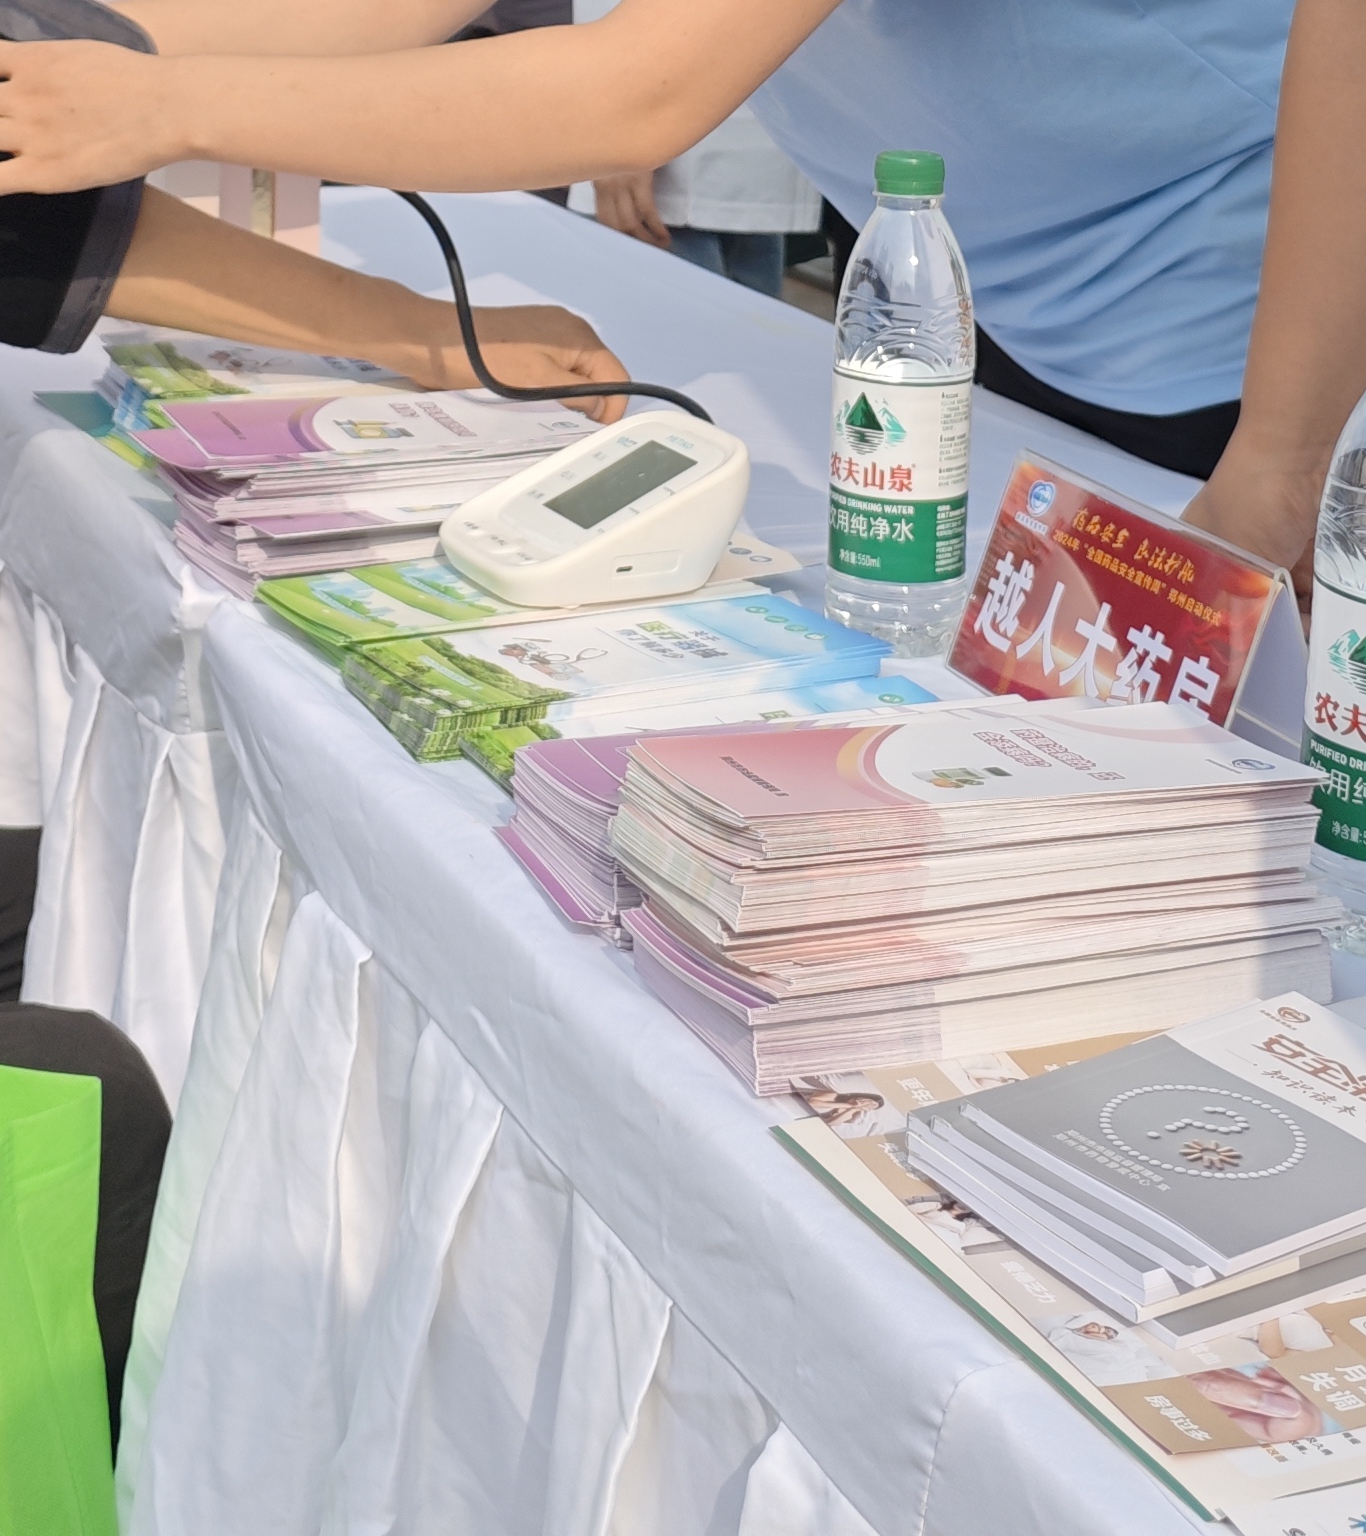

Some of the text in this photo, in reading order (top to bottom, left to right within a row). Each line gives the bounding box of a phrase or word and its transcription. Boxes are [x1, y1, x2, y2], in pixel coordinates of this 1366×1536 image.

[829, 451, 914, 493] 农夫山泉
[847, 497, 882, 514] DRINKING
[883, 505, 915, 515] WATER
[1310, 738, 1347, 765] PURIFIED
[896, 1077, 939, 1106] 更年
[1300, 1371, 1366, 1411] 失调
[1143, 1394, 1213, 1442] 房事过多
